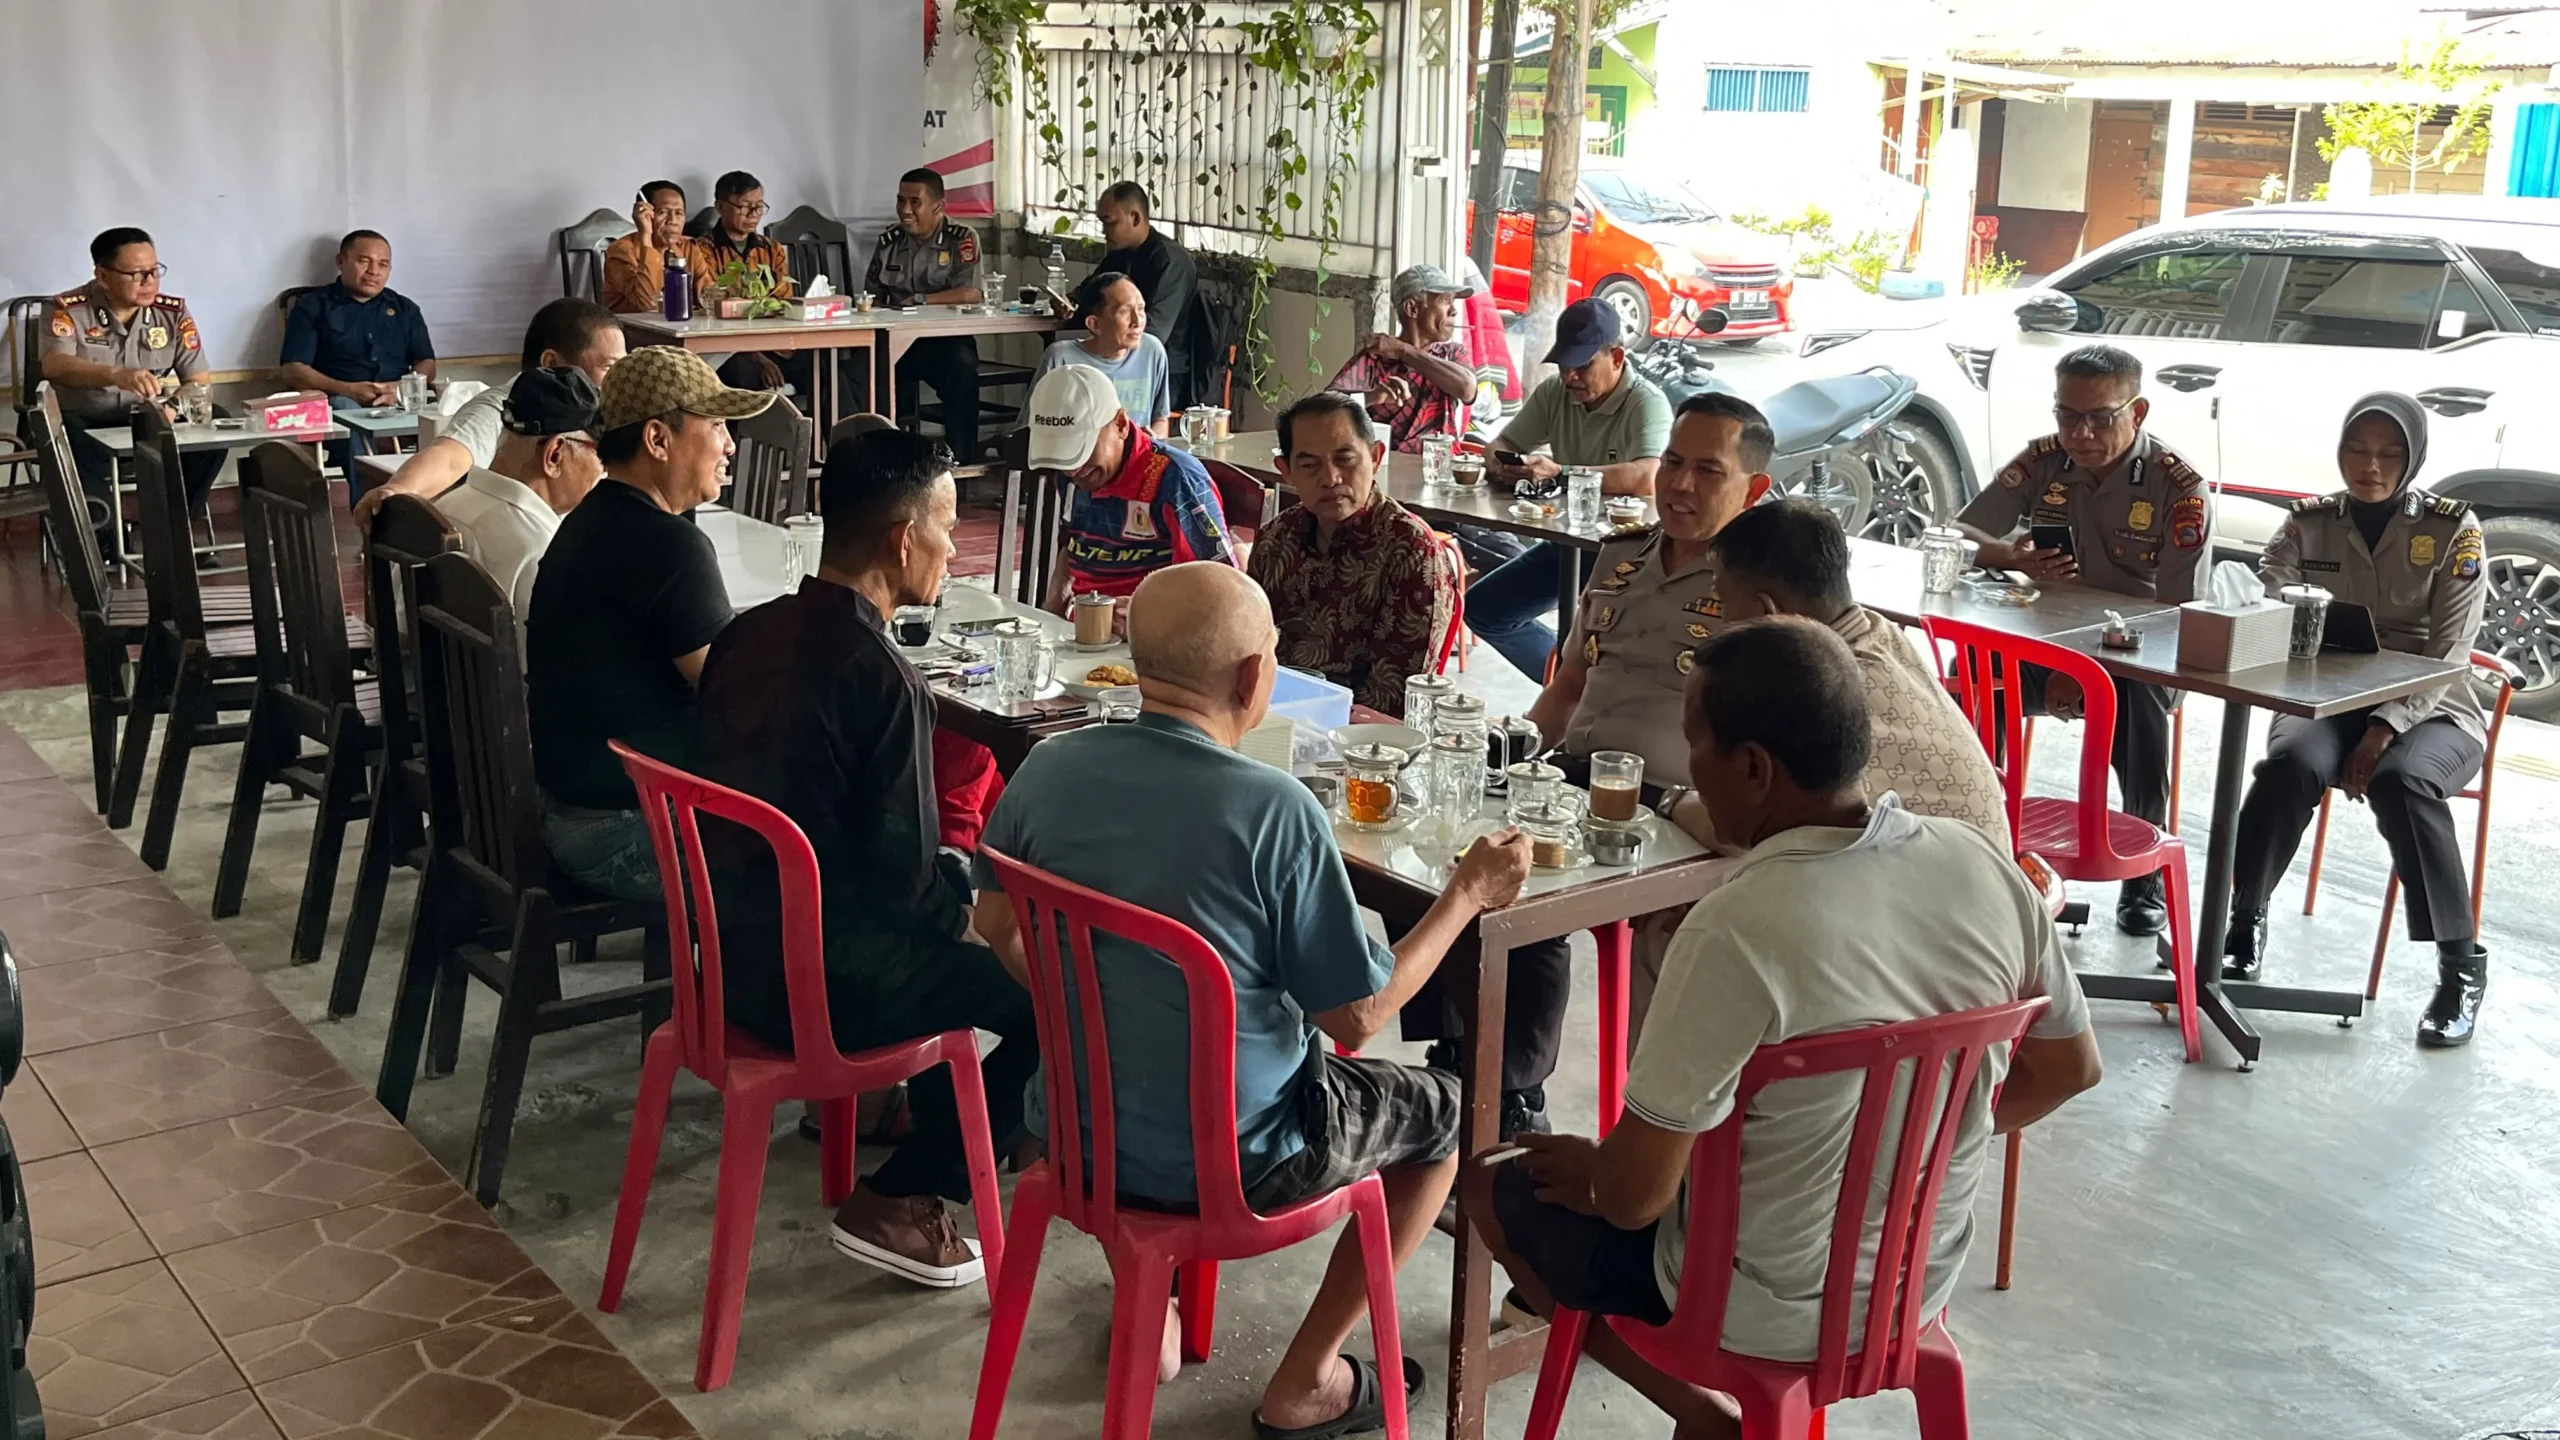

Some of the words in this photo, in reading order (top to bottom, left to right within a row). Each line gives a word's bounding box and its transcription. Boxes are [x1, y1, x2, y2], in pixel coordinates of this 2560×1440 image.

[923, 110, 947, 128] AT
[1034, 414, 1075, 427] Reebok
[2172, 498, 2202, 509] POLDA
